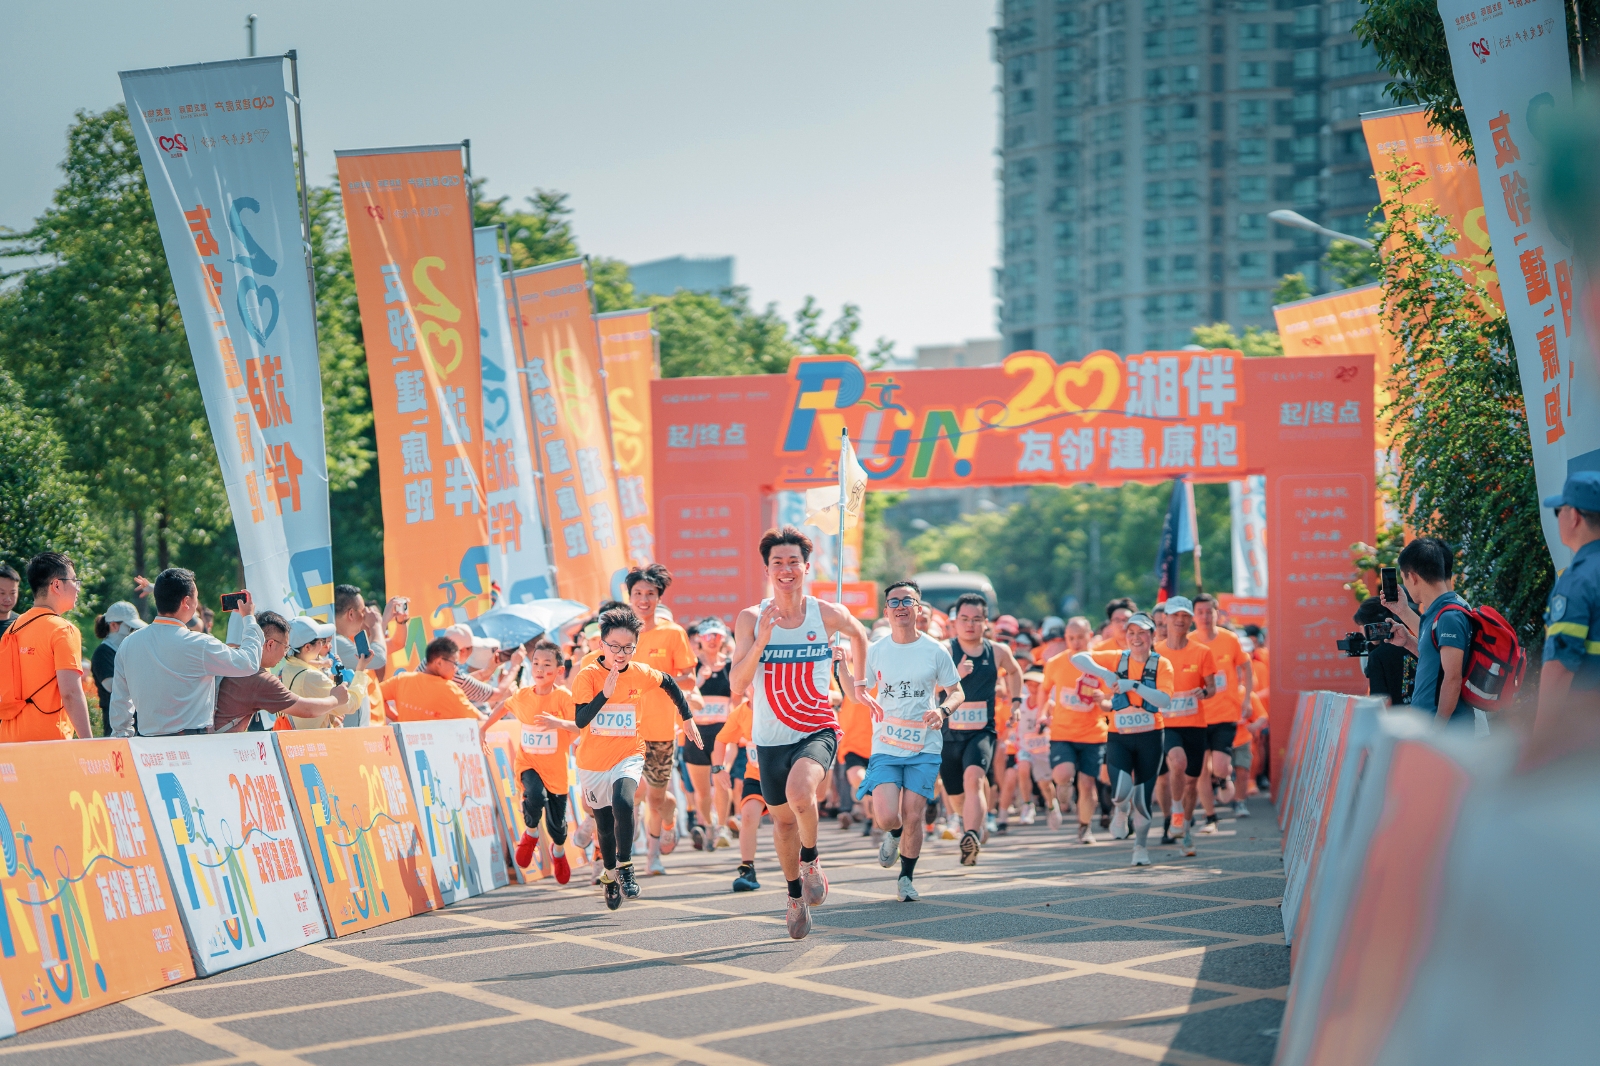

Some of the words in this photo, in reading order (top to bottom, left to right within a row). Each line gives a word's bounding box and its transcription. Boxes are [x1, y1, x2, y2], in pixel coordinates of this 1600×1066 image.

[1126, 355, 1236, 419] 湘伴
[1279, 400, 1361, 427] 起/终点
[1018, 424, 1238, 472] 友邻「建」康跑
[761, 649, 794, 662] yun
[796, 645, 828, 659] club
[596, 713, 632, 727] 0705
[952, 708, 983, 721] 0181
[1119, 713, 1151, 726] 0303
[523, 733, 551, 746] 0671
[886, 725, 921, 743] 0425
[104, 790, 147, 858] 湘伴
